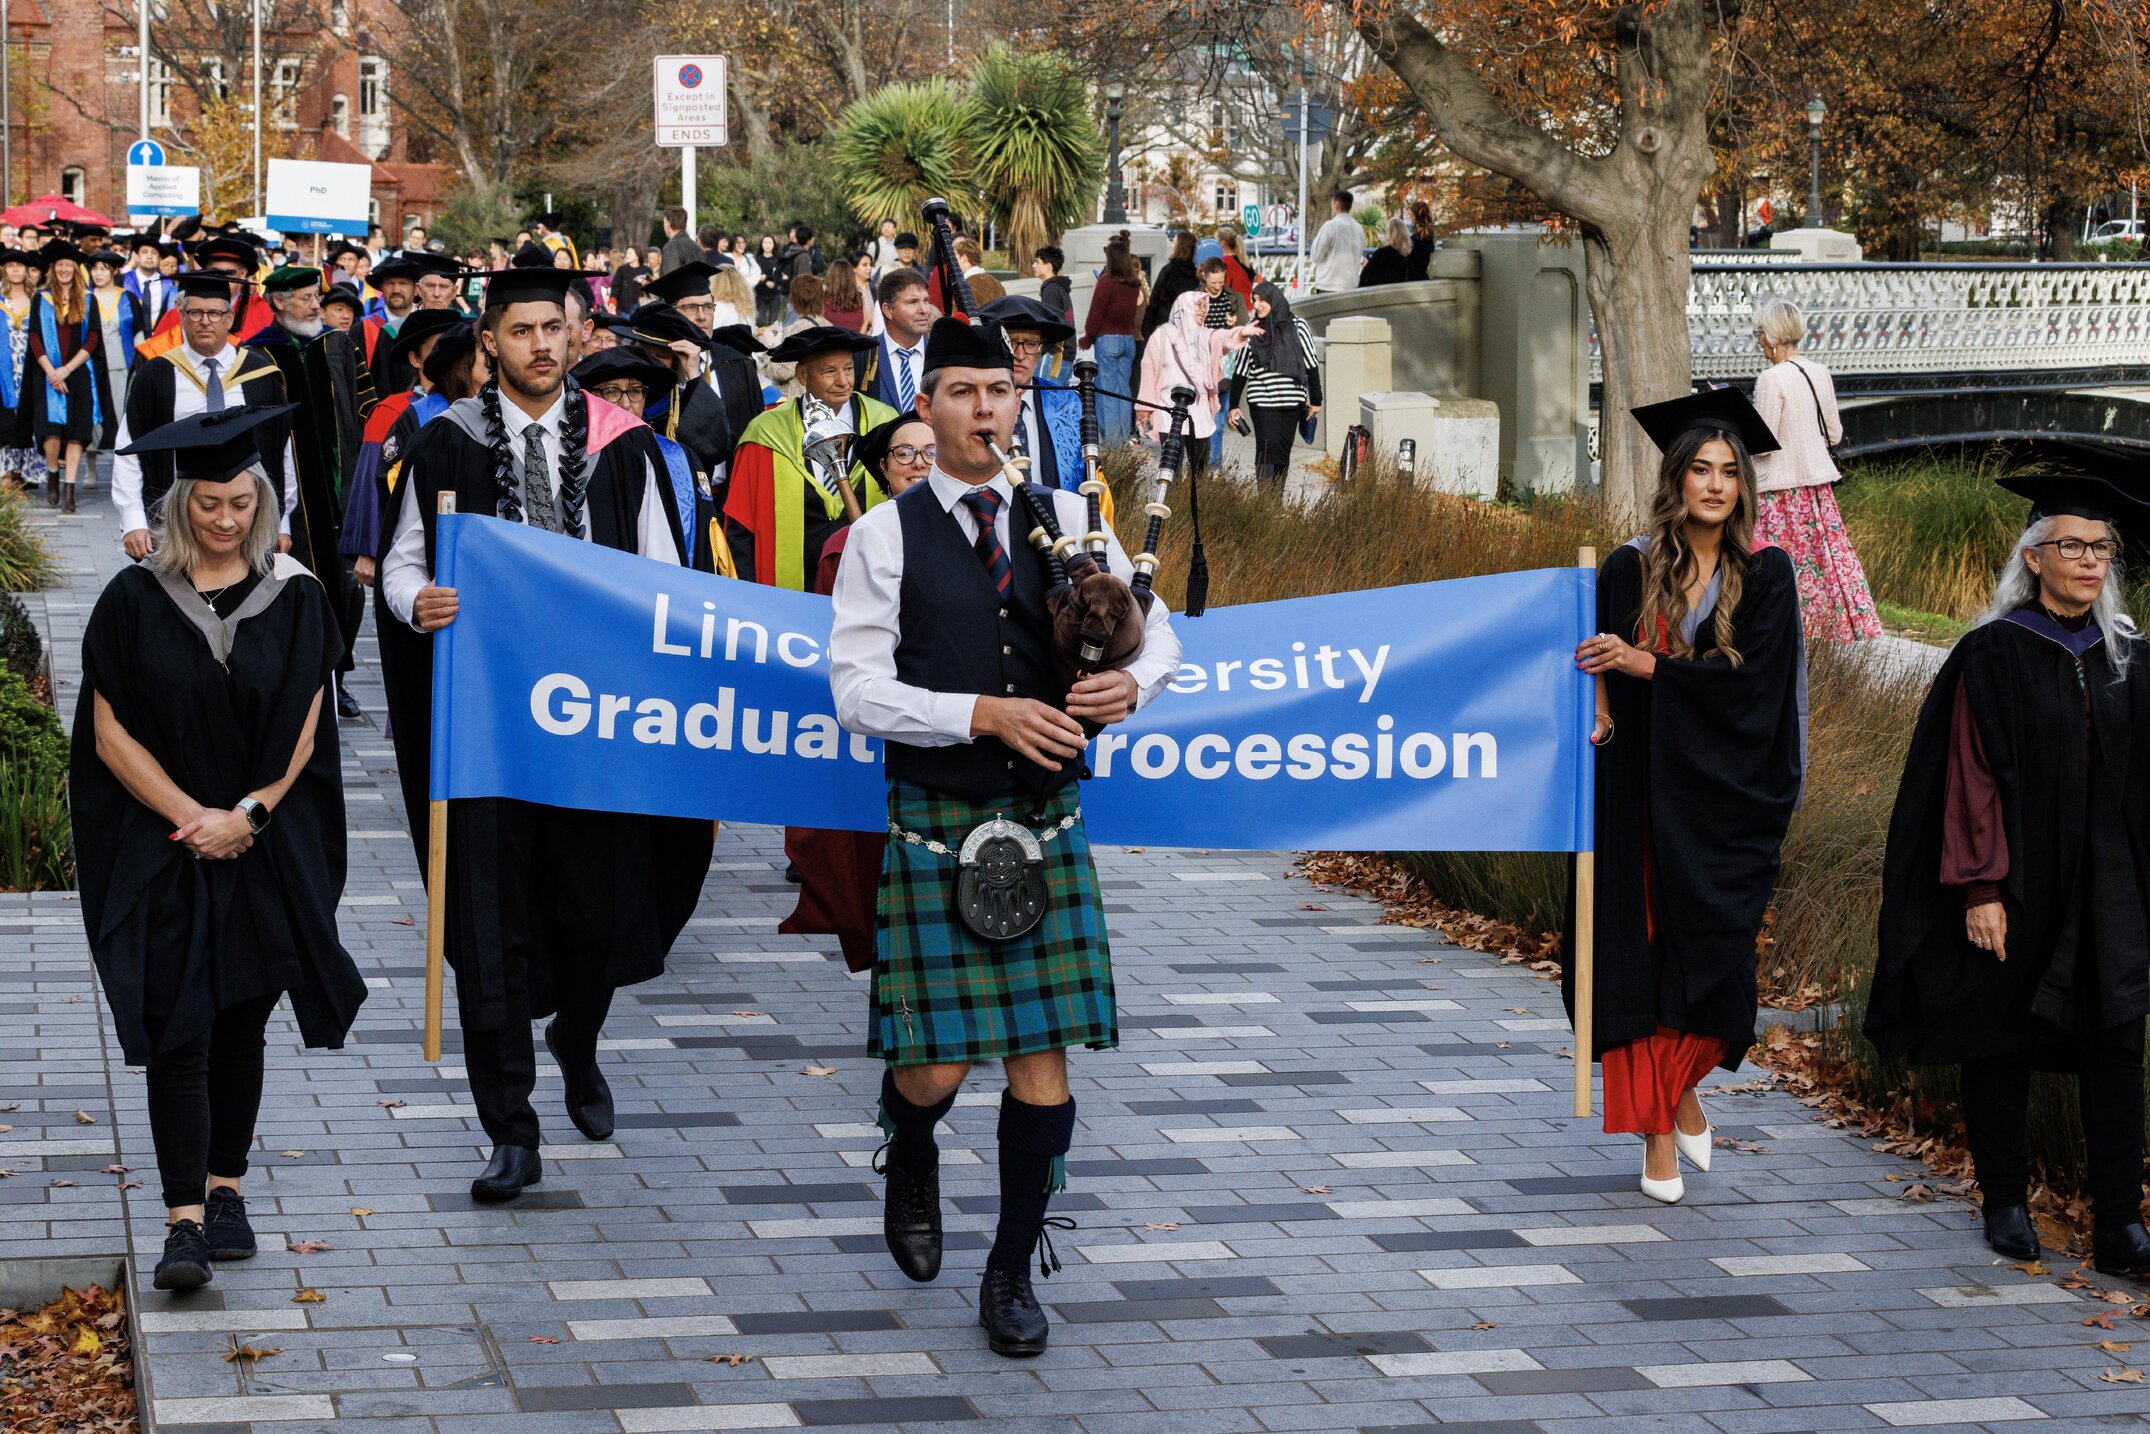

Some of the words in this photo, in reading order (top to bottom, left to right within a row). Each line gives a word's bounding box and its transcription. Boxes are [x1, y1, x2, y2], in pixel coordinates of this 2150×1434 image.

[668, 92, 702, 101] Except
[706, 92, 715, 100] in
[662, 103, 720, 112] Signposted
[672, 129, 711, 140] ENDS
[149, 183, 177, 191] Applied
[310, 186, 327, 194] PhD
[143, 191, 183, 199] Computing
[1245, 208, 1259, 228] GO
[652, 592, 830, 669] Linc
[1166, 641, 1391, 704] ersity
[530, 672, 885, 764] Graduat
[1094, 713, 1498, 781] rocession
